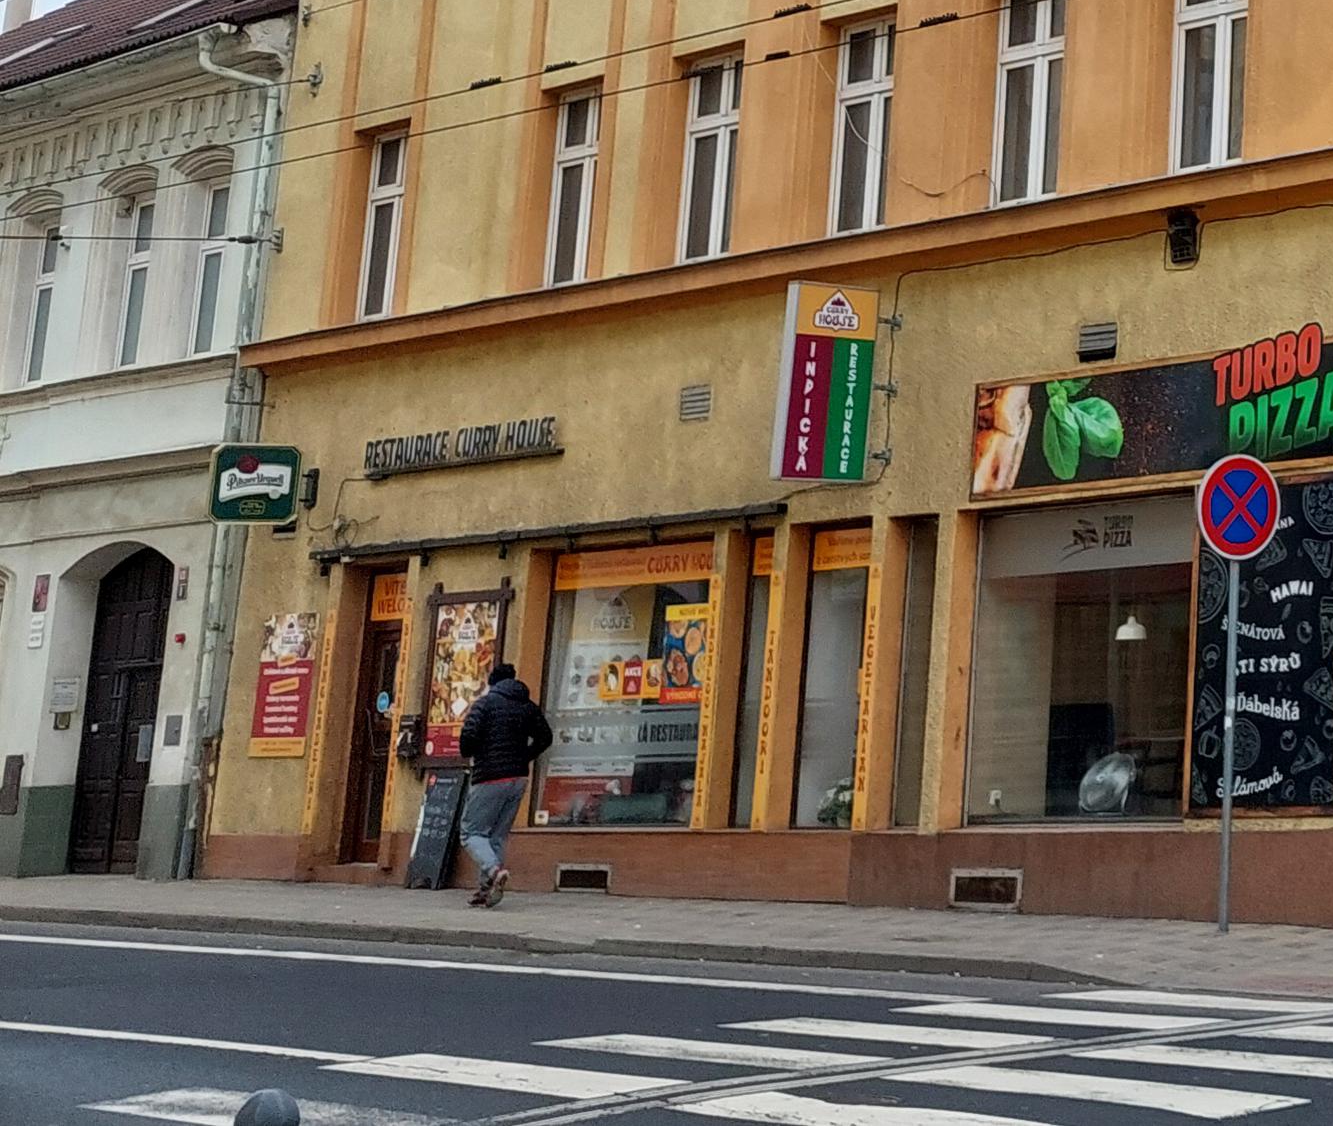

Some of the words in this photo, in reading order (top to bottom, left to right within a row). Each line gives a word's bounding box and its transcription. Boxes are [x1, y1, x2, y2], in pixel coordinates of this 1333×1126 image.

[818, 314, 856, 328] HOUSE
[1212, 321, 1323, 406] TURBO
[839, 342, 860, 474] RESTAURACE
[363, 430, 450, 470] RESTAURACE
[455, 423, 500, 458] CURRY
[505, 416, 557, 451] HOUSE
[1103, 515, 1134, 531] TURBO
[1102, 529, 1133, 549] PIZZA
[646, 553, 690, 574] CURRY
[1269, 579, 1314, 604] HAWAI
[1221, 614, 1286, 641] ŠENÁTOVÁ
[1235, 657, 1255, 675] TI
[1259, 651, 1301, 673] SÝRŮ
[758, 630, 777, 775] TANDOORI
[1215, 765, 1284, 799] Slámová
